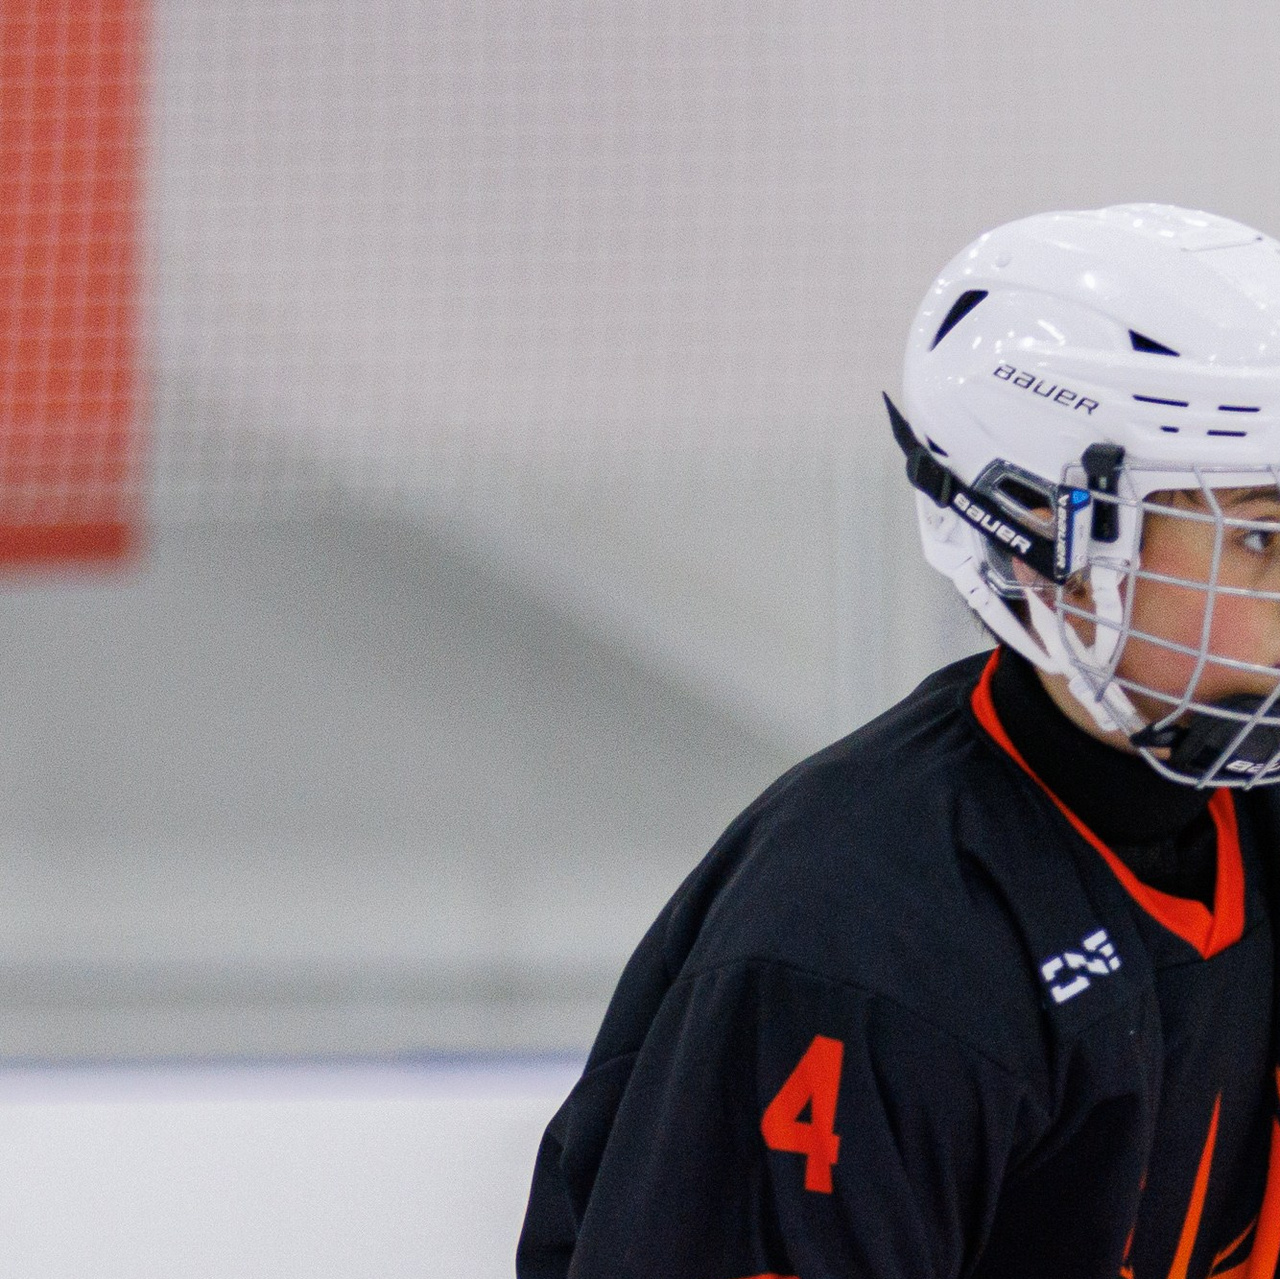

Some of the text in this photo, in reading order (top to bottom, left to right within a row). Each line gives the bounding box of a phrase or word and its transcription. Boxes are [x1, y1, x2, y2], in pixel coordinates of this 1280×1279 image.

[993, 364, 1099, 415] BAUER
[953, 492, 1031, 554] BAUER
[761, 1033, 844, 1194] 4
